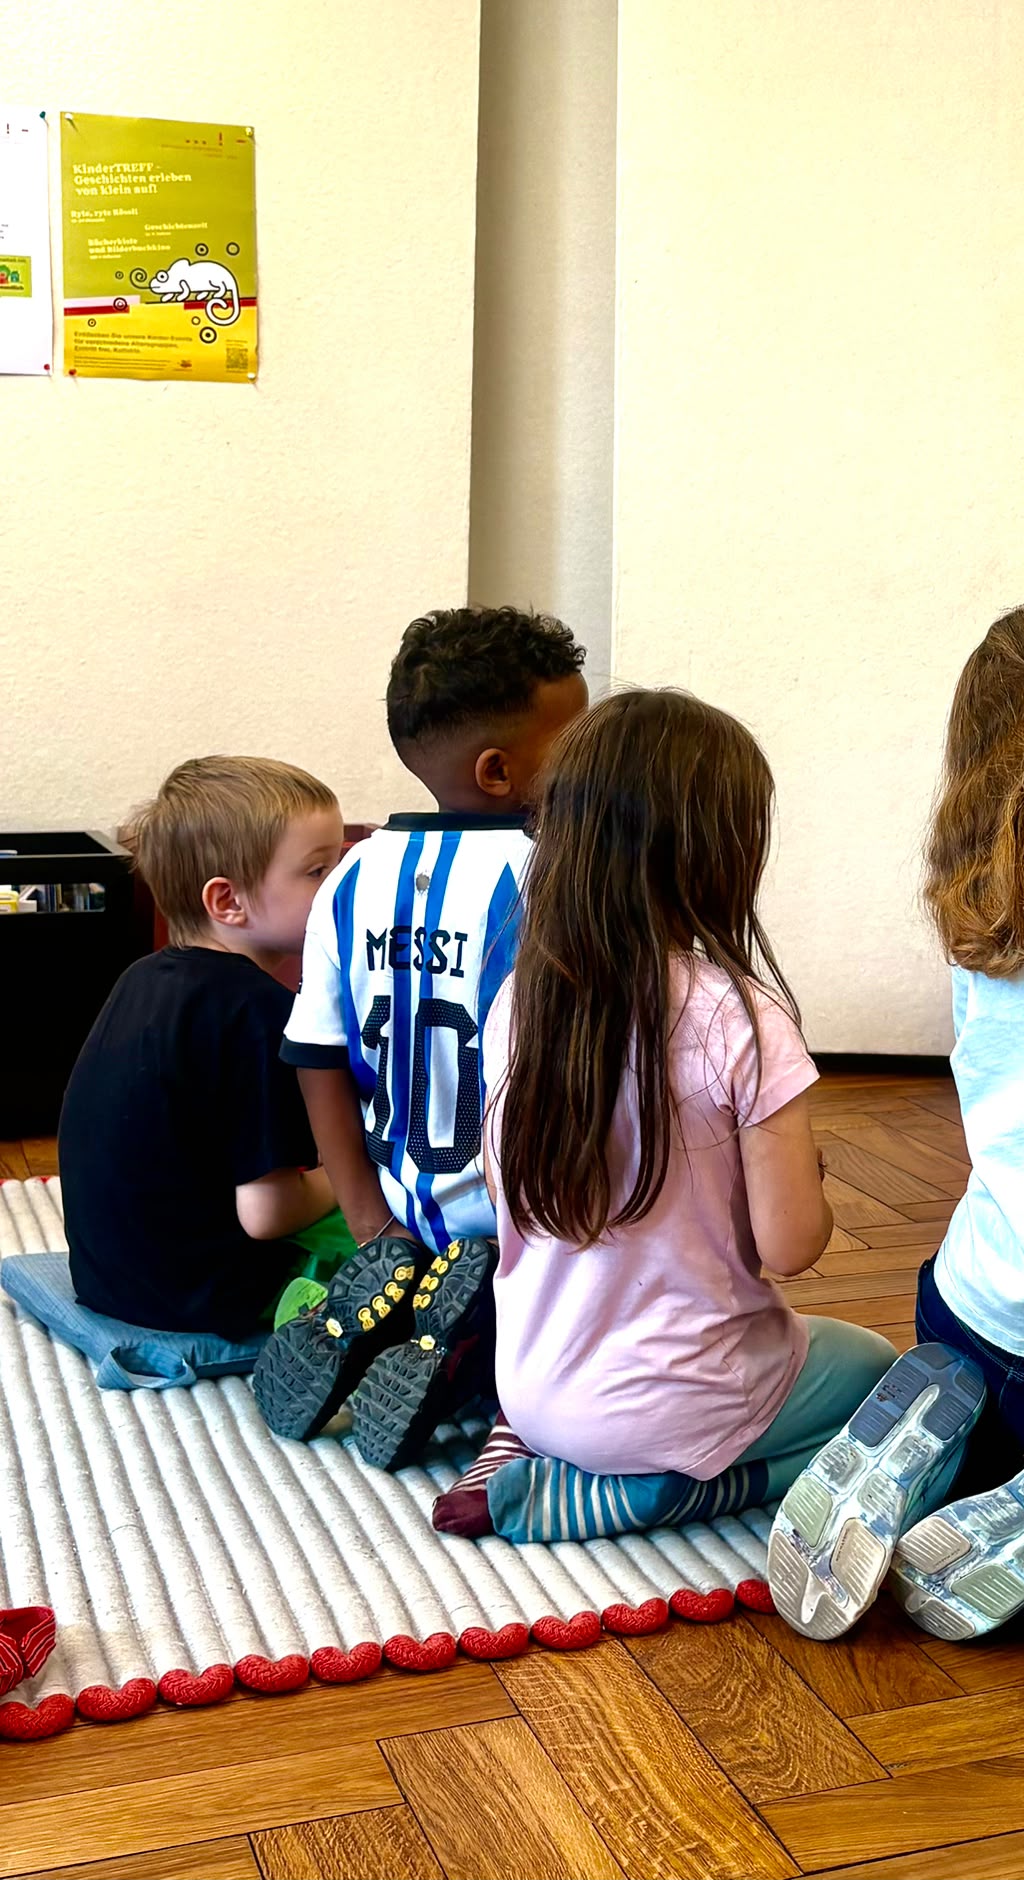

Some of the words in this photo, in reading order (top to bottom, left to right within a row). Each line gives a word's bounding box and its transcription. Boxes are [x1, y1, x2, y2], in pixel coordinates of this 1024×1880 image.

[73, 162, 154, 174] KinderTREFF
[74, 173, 147, 185] Geschichten
[149, 172, 192, 182] erleben
[75, 186, 98, 196] von
[100, 184, 131, 195] klein
[366, 925, 468, 978] MESSI
[360, 994, 481, 1174] 10
